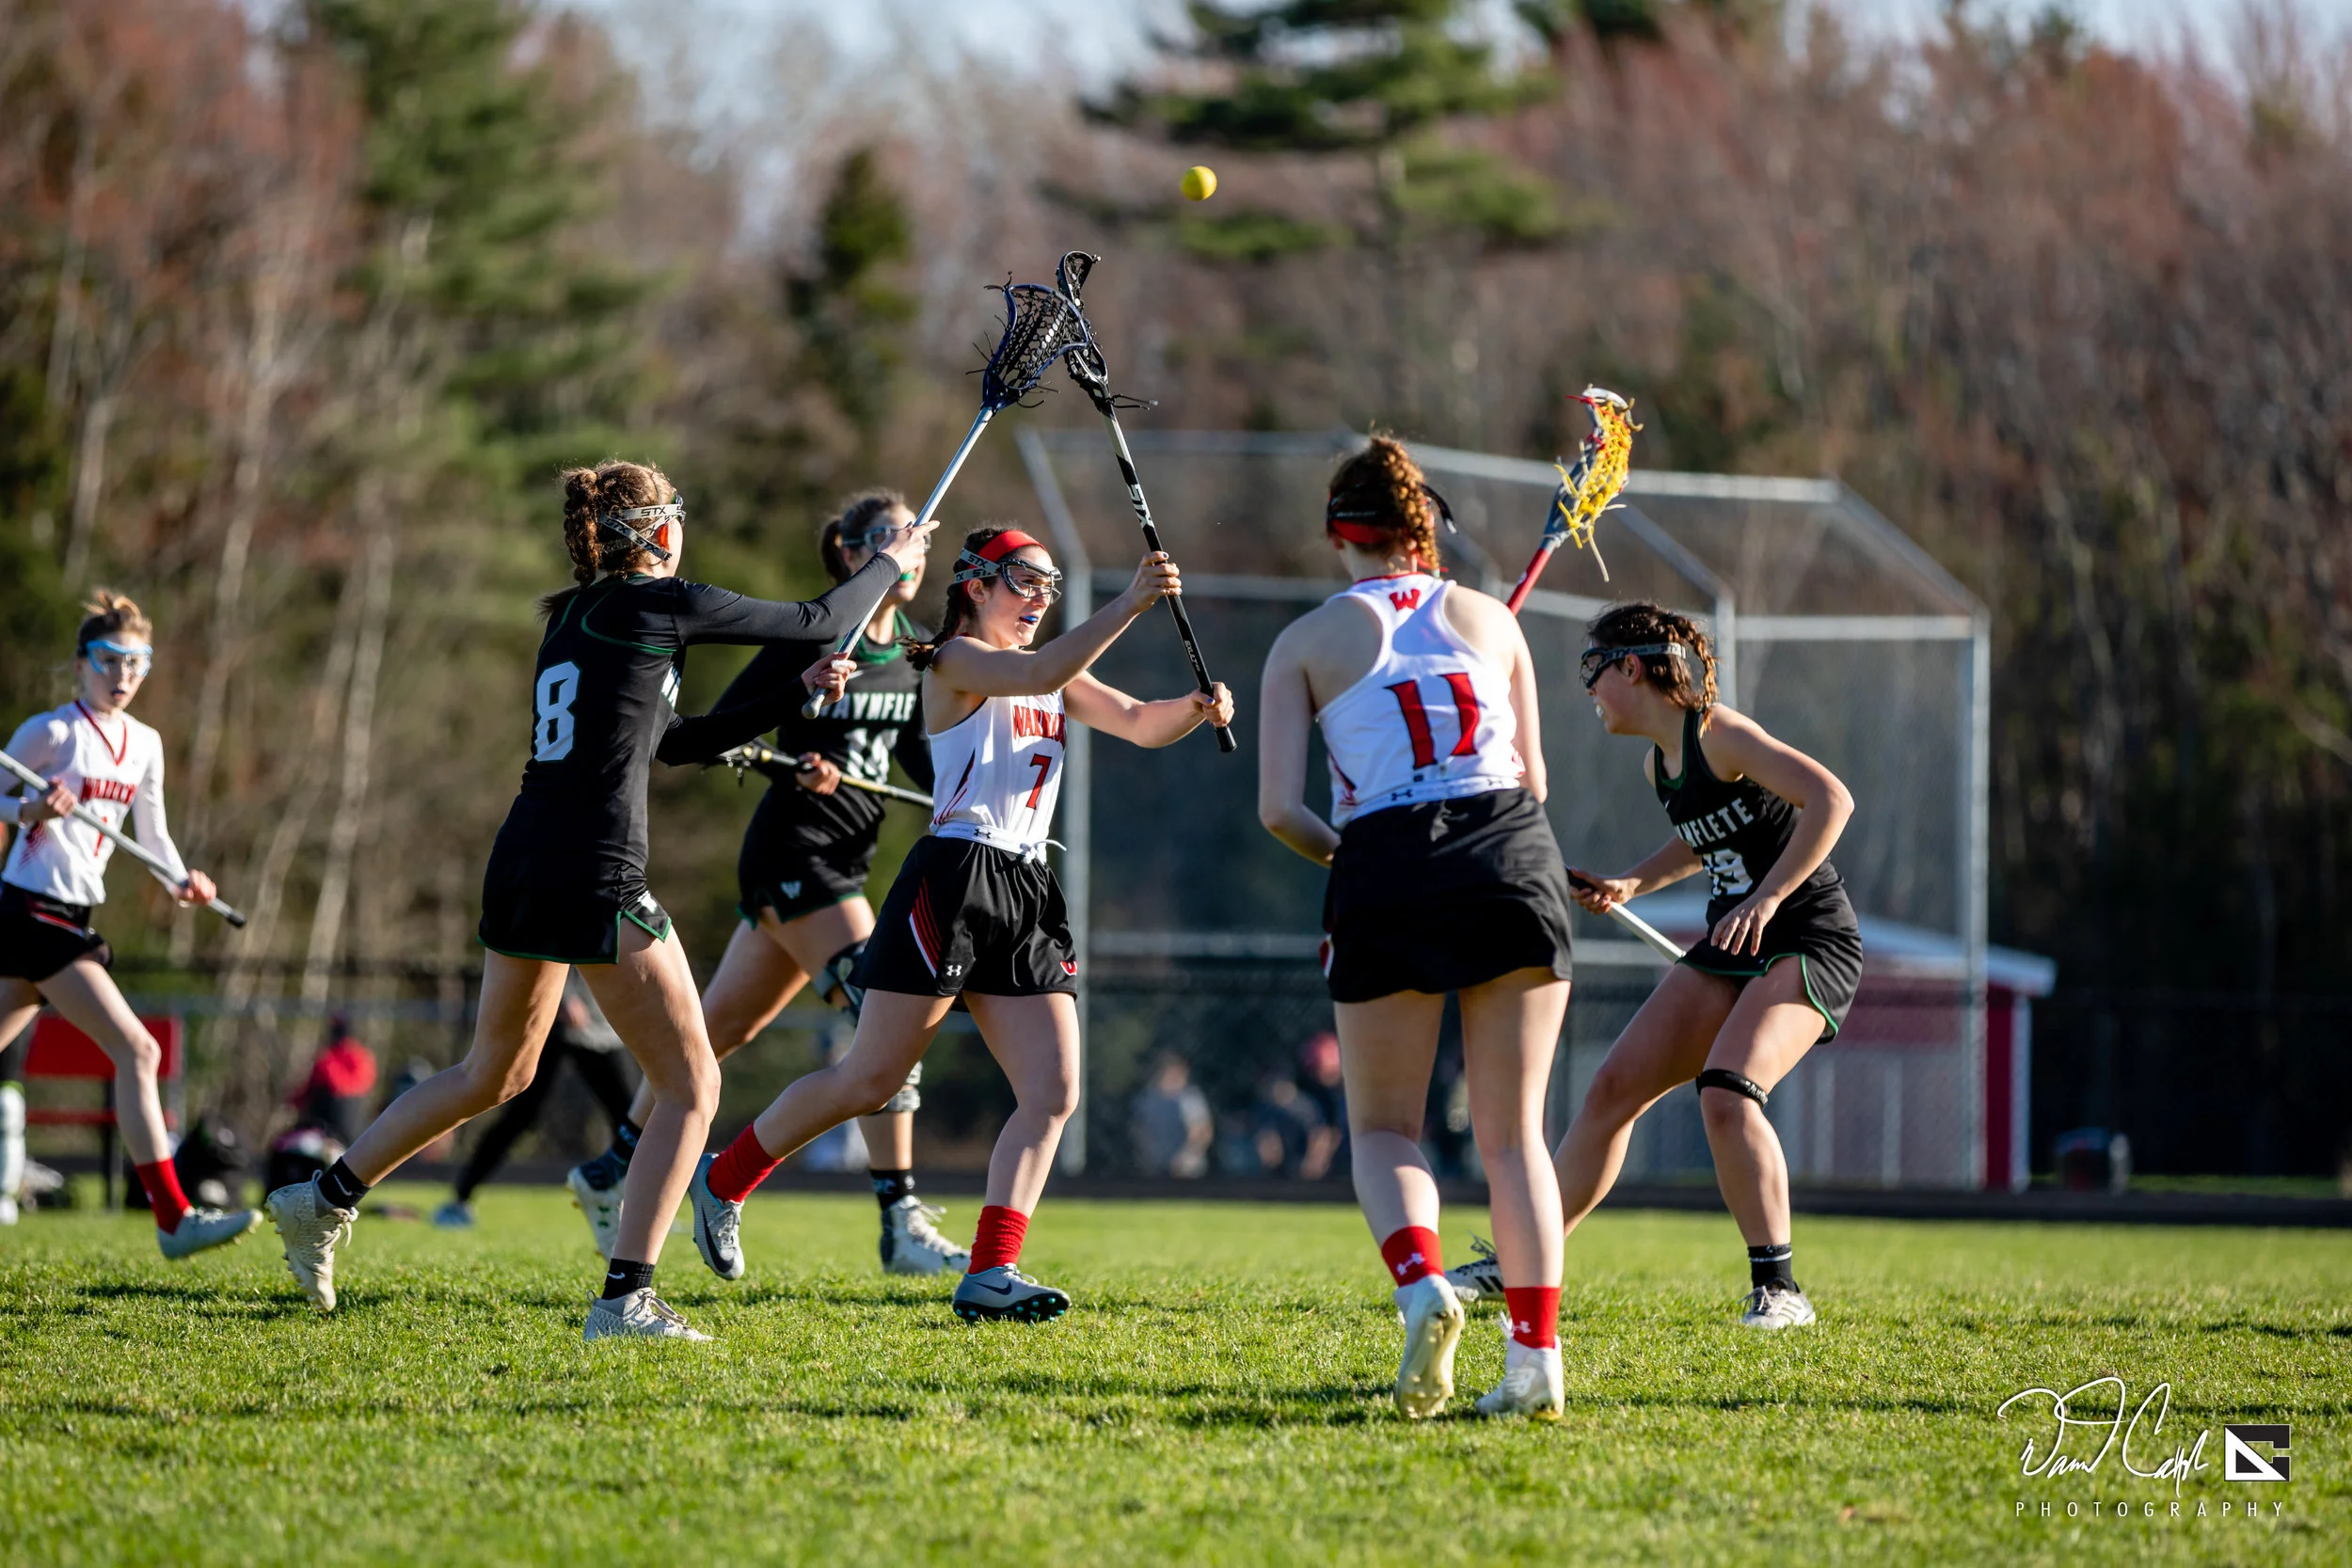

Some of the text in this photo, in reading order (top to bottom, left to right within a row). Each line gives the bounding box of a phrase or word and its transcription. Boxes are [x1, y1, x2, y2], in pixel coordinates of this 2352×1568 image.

[641, 506, 666, 517] STX
[1127, 483, 1154, 529] STX
[968, 554, 989, 568] STX
[1389, 588, 1421, 612] W
[533, 660, 580, 763] 8
[1384, 673, 1478, 769] 11
[1026, 753, 1053, 810] 7
